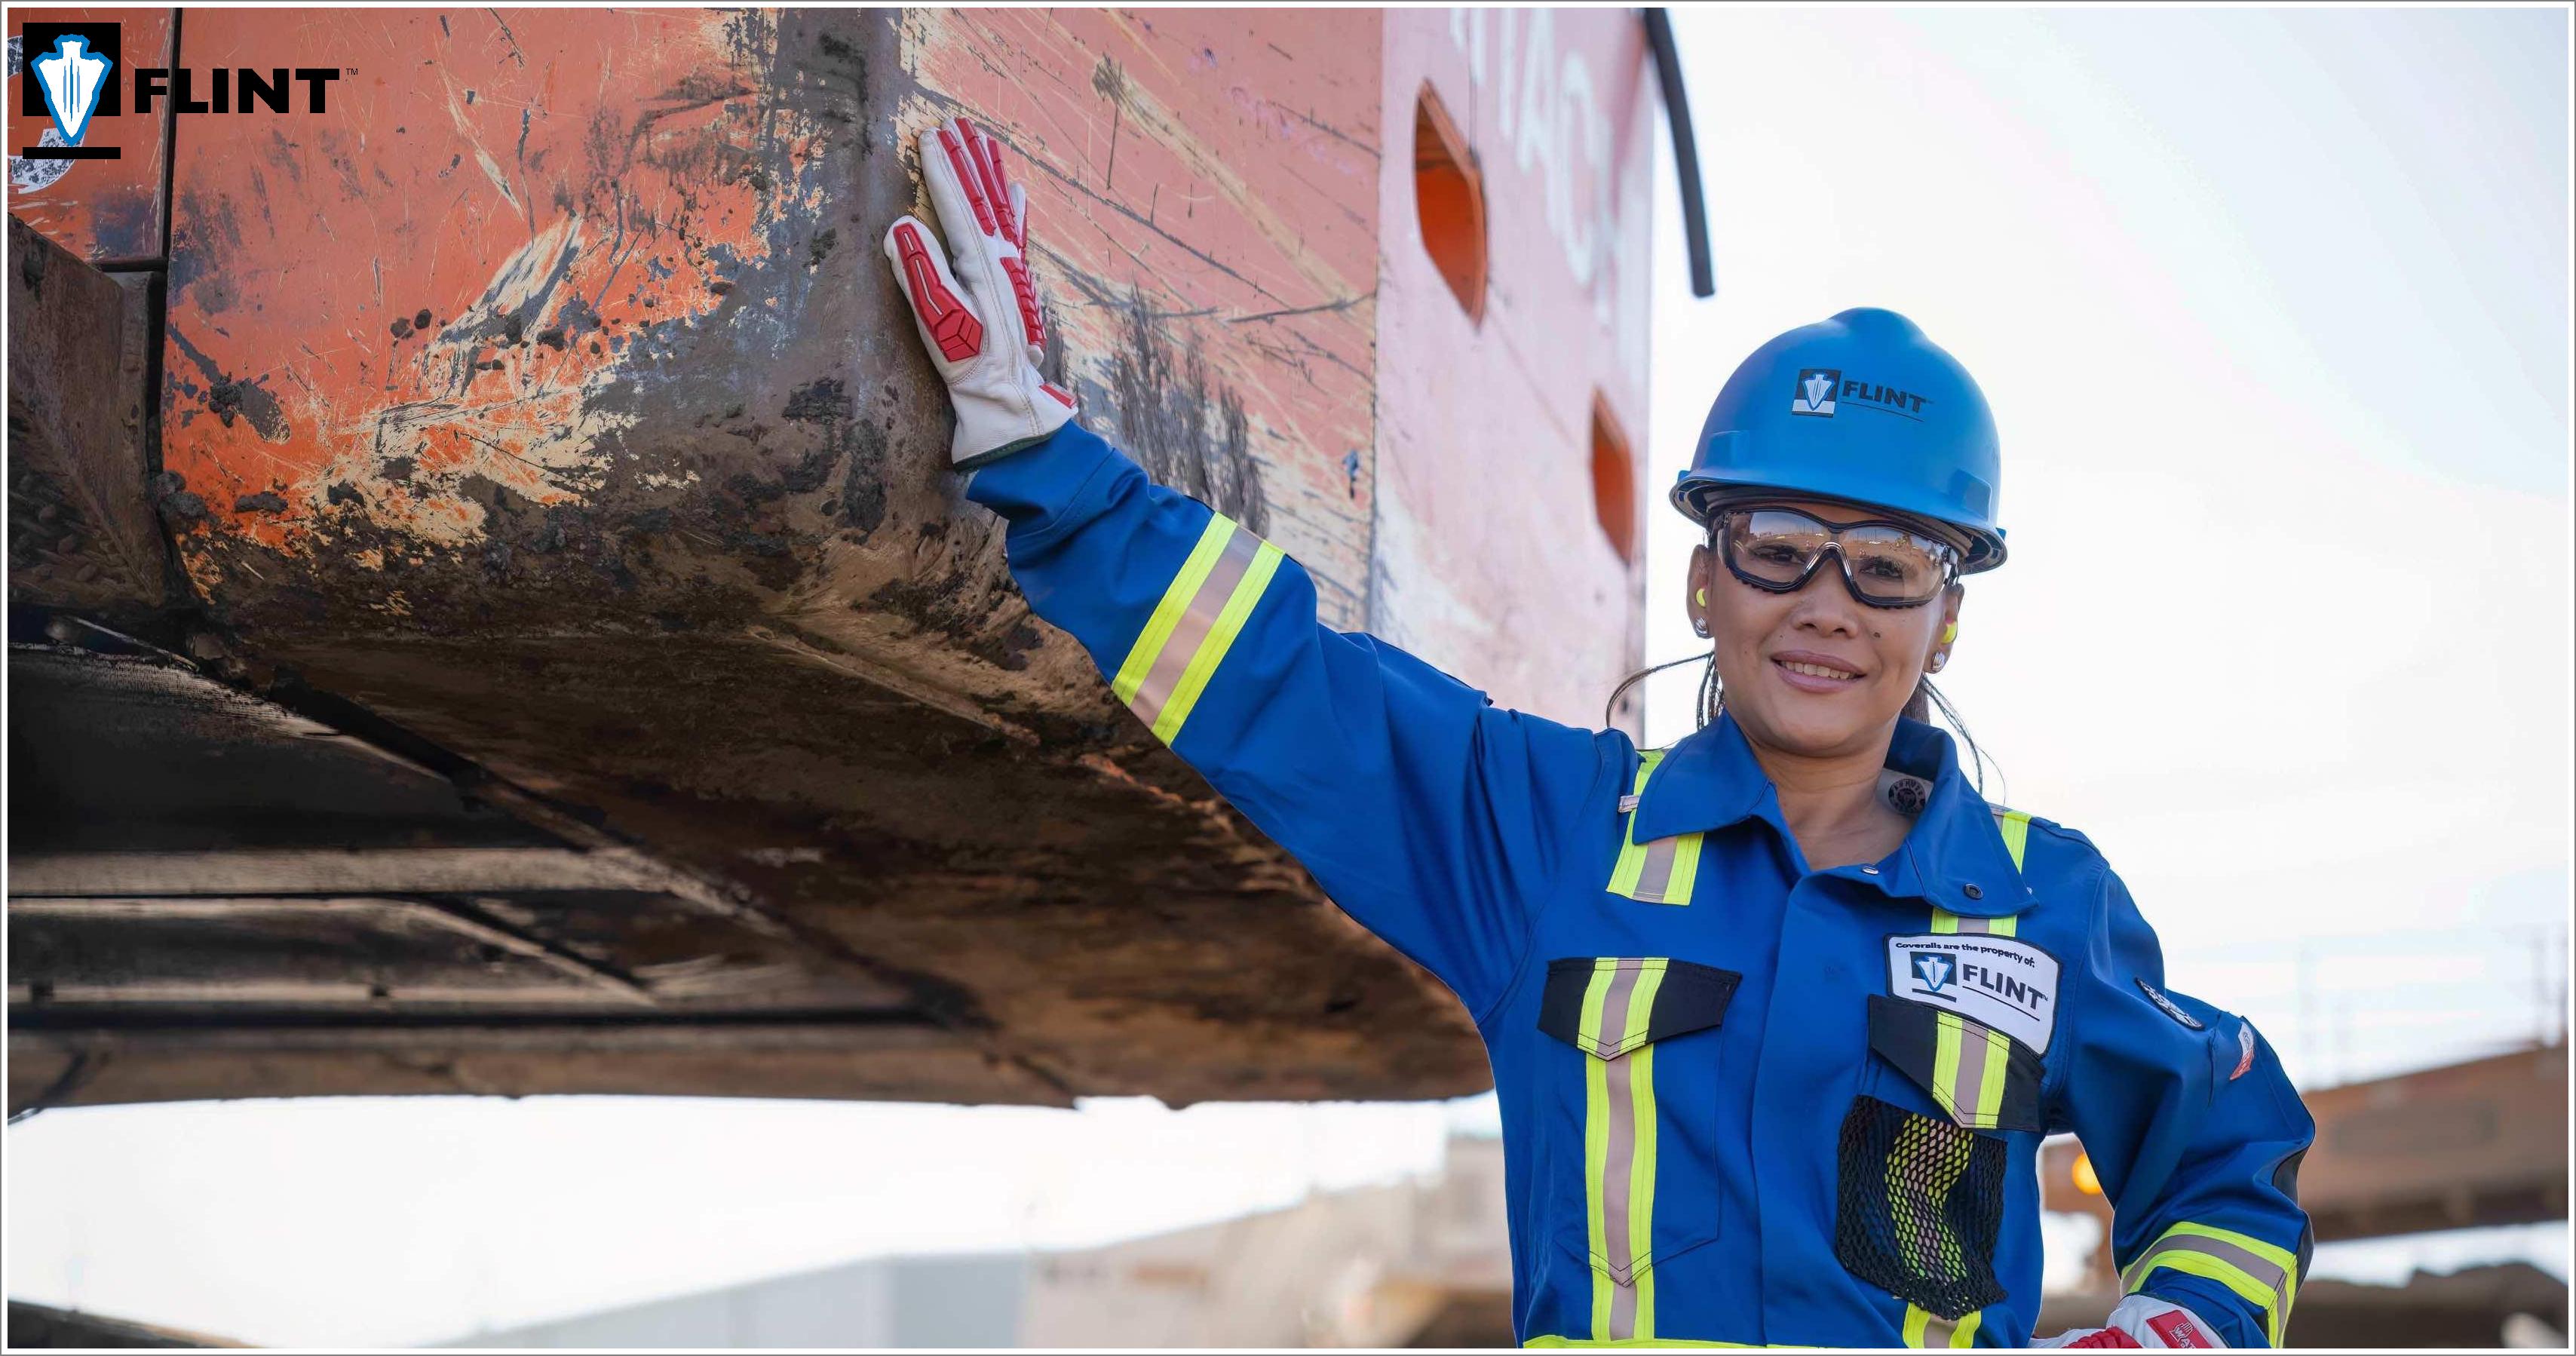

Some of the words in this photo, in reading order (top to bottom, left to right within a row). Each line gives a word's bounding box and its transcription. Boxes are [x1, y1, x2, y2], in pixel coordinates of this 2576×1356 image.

[1842, 380, 1926, 413] FLINT
[1980, 946, 2022, 963] property
[1963, 963, 2043, 1010] FLINT
